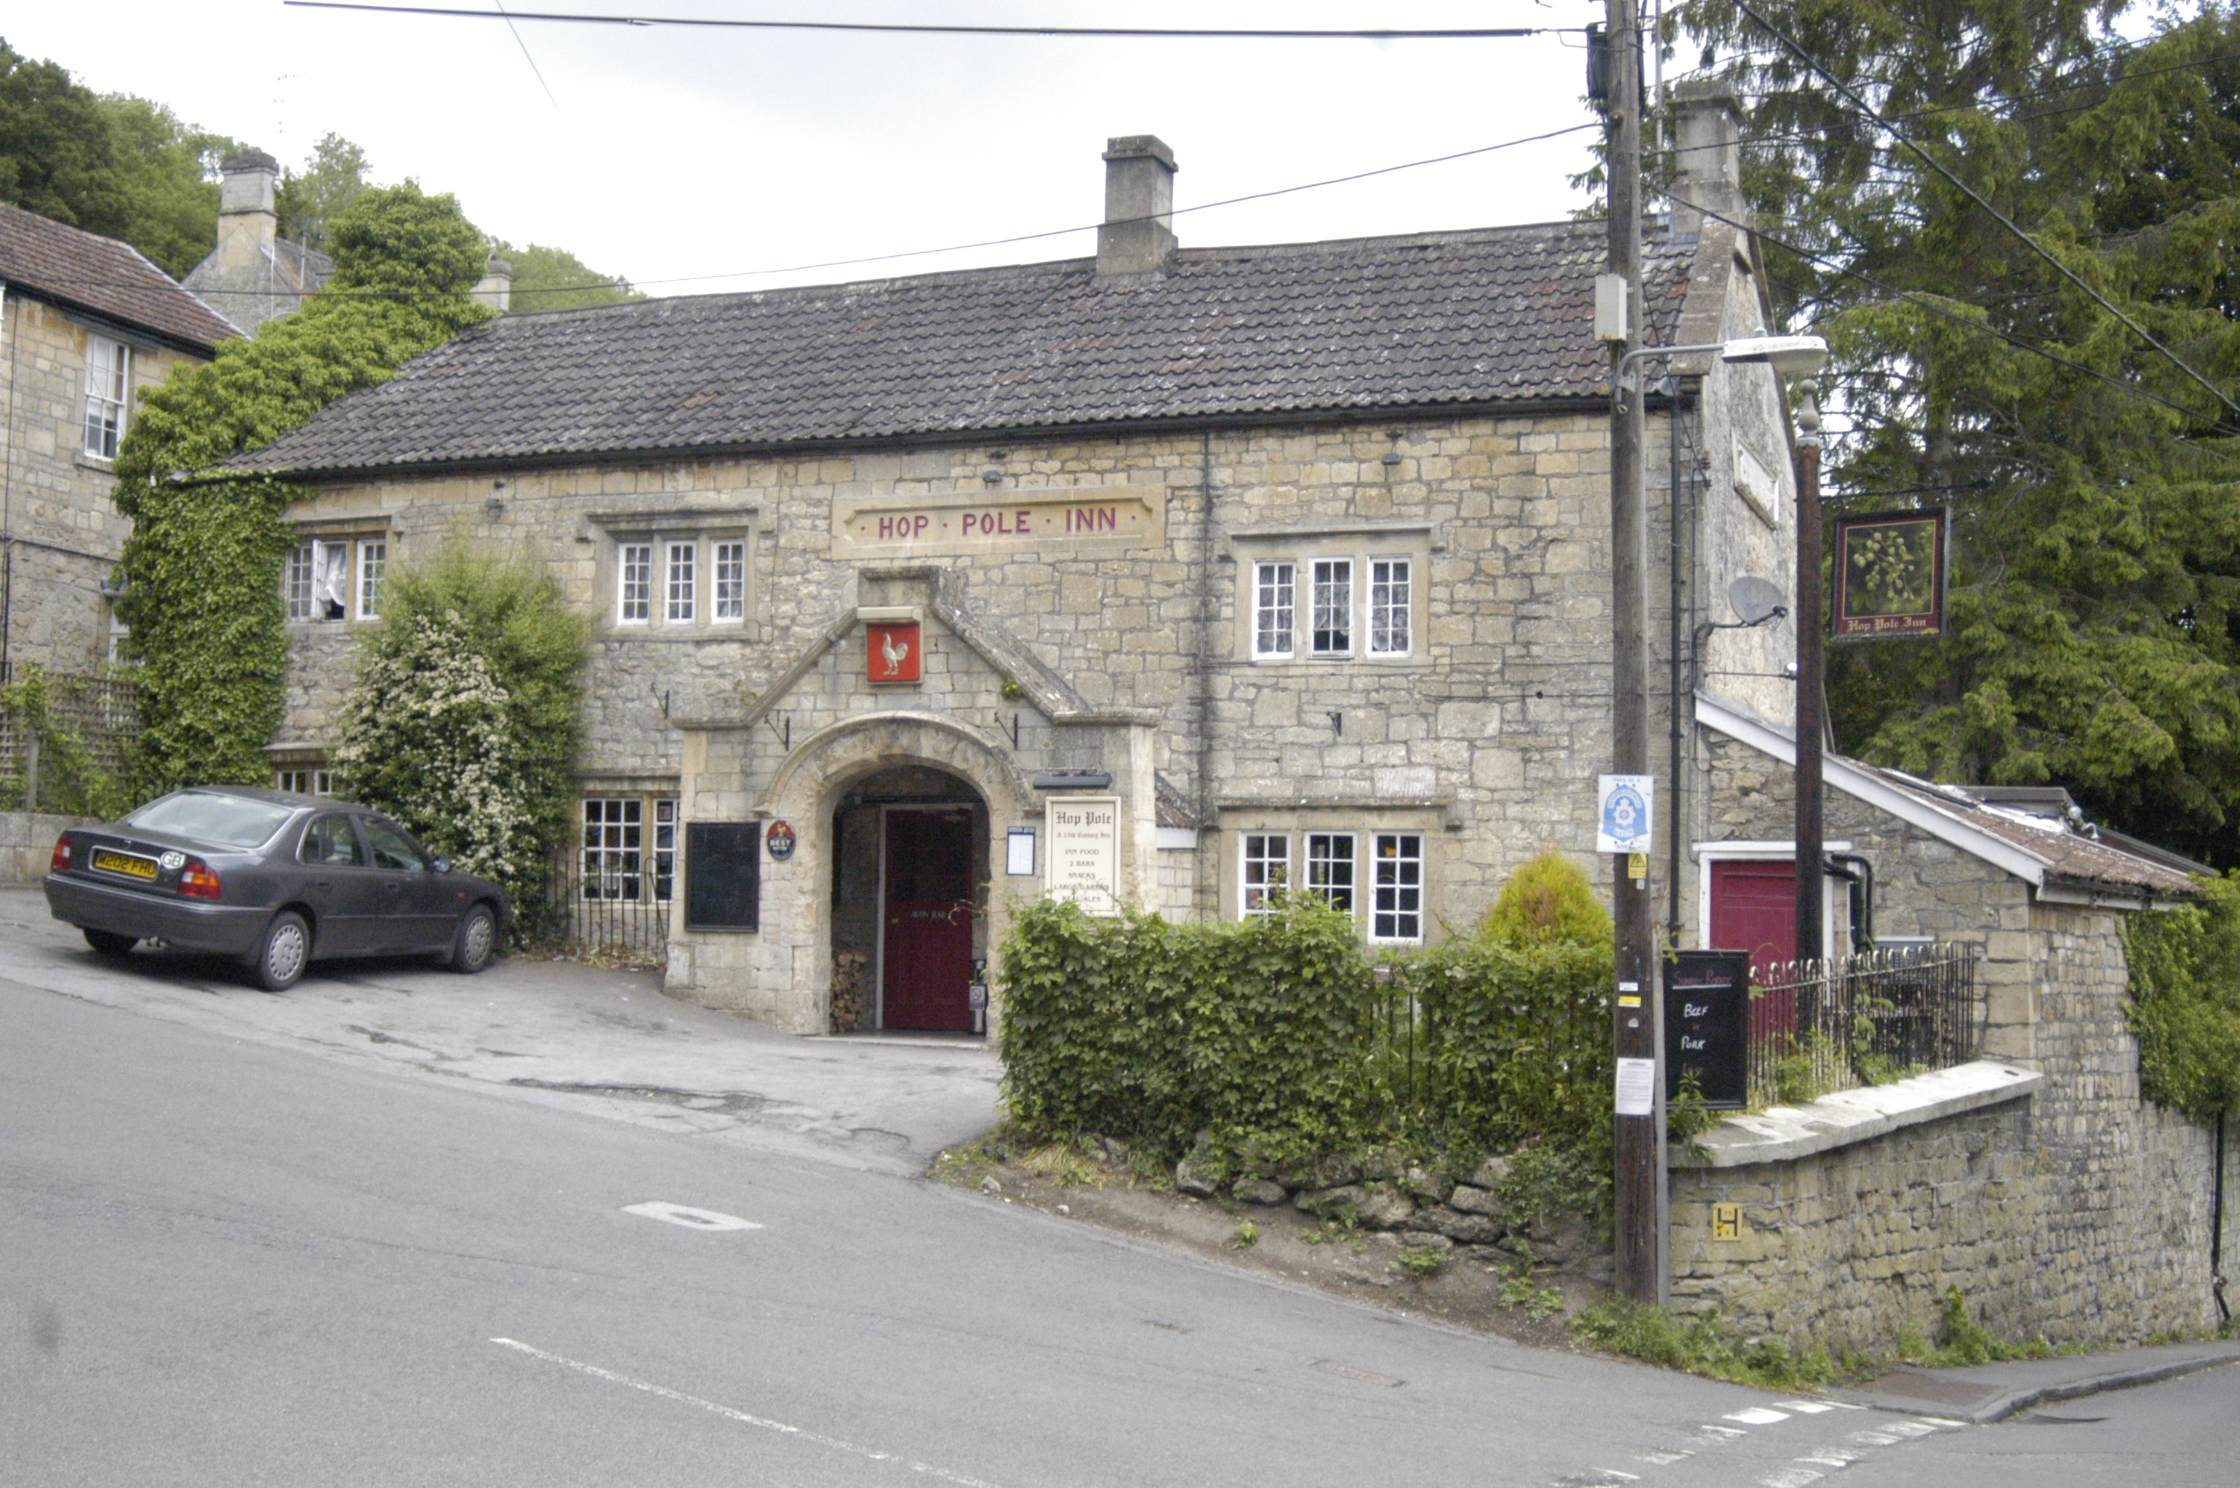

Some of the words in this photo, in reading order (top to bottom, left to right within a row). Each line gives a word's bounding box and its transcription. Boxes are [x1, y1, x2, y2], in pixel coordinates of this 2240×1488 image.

[879, 515, 929, 539] HOP
[962, 510, 1031, 536] POLE
[1065, 507, 1117, 533] INN
[1847, 619, 1871, 632] Hop
[1873, 617, 1899, 631] Pole
[1901, 616, 1927, 628] Inn
[1056, 812, 1081, 826] Hop
[1085, 811, 1112, 826] Pole
[162, 853, 182, 867] GB
[1718, 1207, 1738, 1237] H
